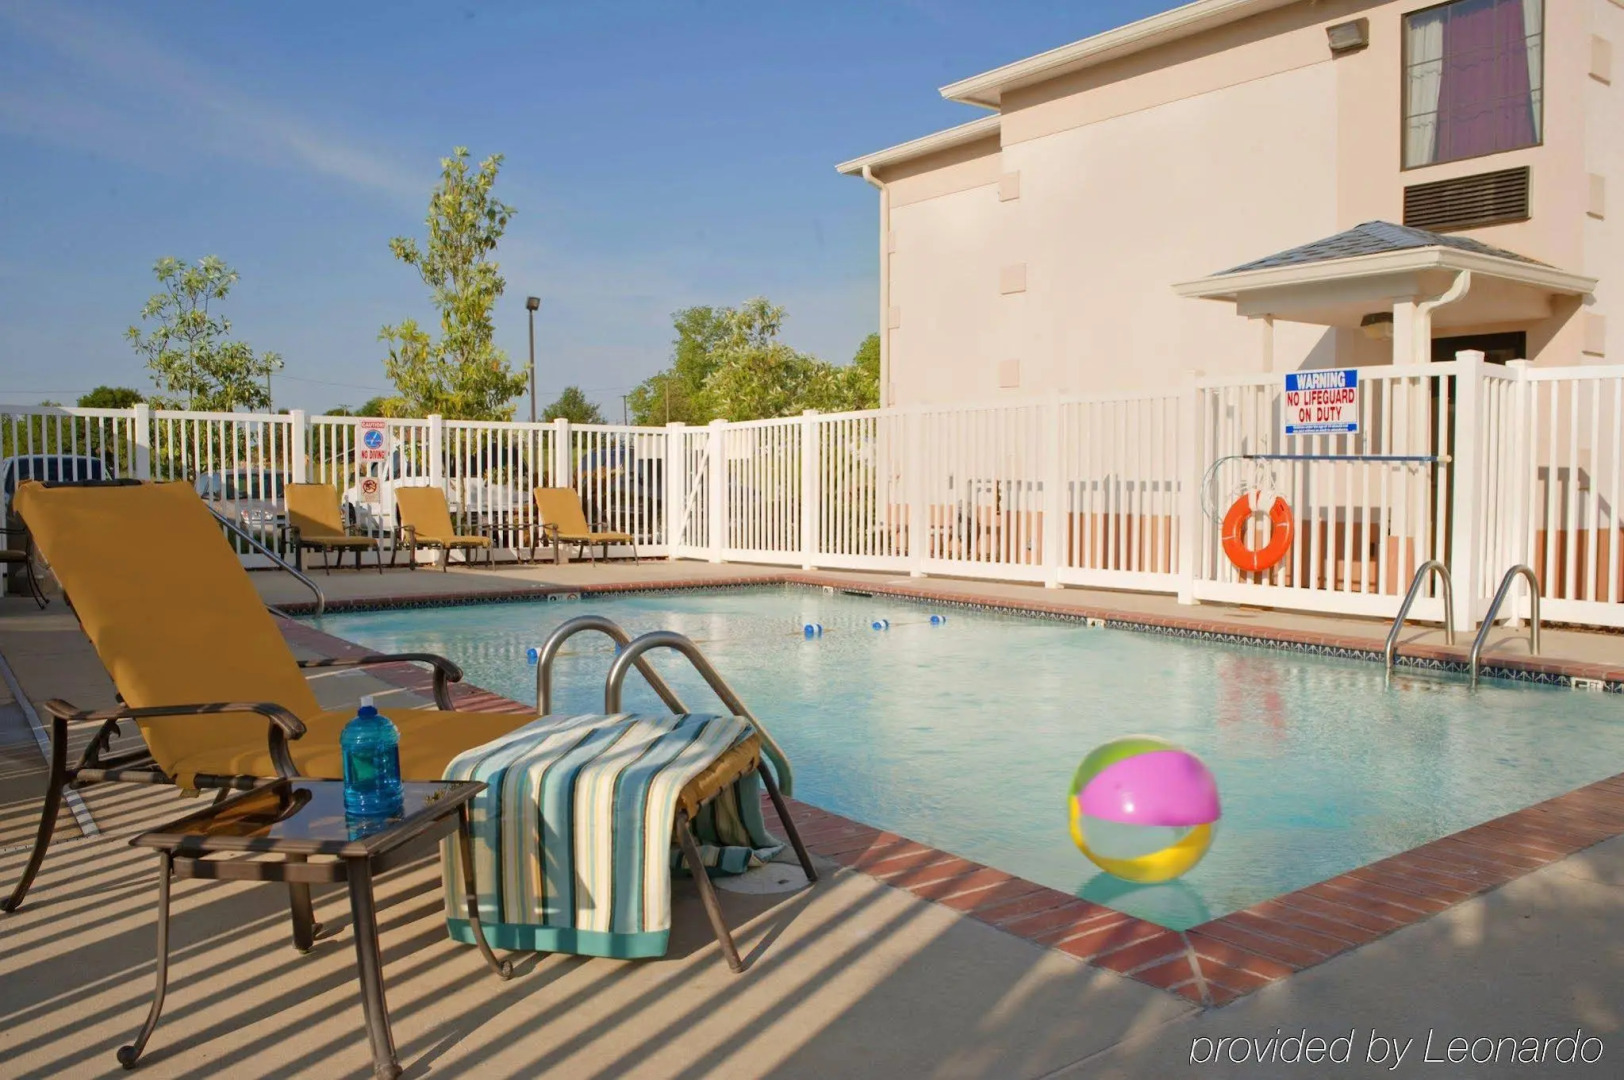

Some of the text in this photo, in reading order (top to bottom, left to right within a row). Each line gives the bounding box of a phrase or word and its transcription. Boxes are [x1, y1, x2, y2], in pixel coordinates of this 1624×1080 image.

[1297, 372, 1345, 390] WARNING
[1287, 389, 1355, 406] NO LIFEGUARD
[1299, 406, 1342, 422] ON DUTY
[361, 450, 385, 459] NO DIVING
